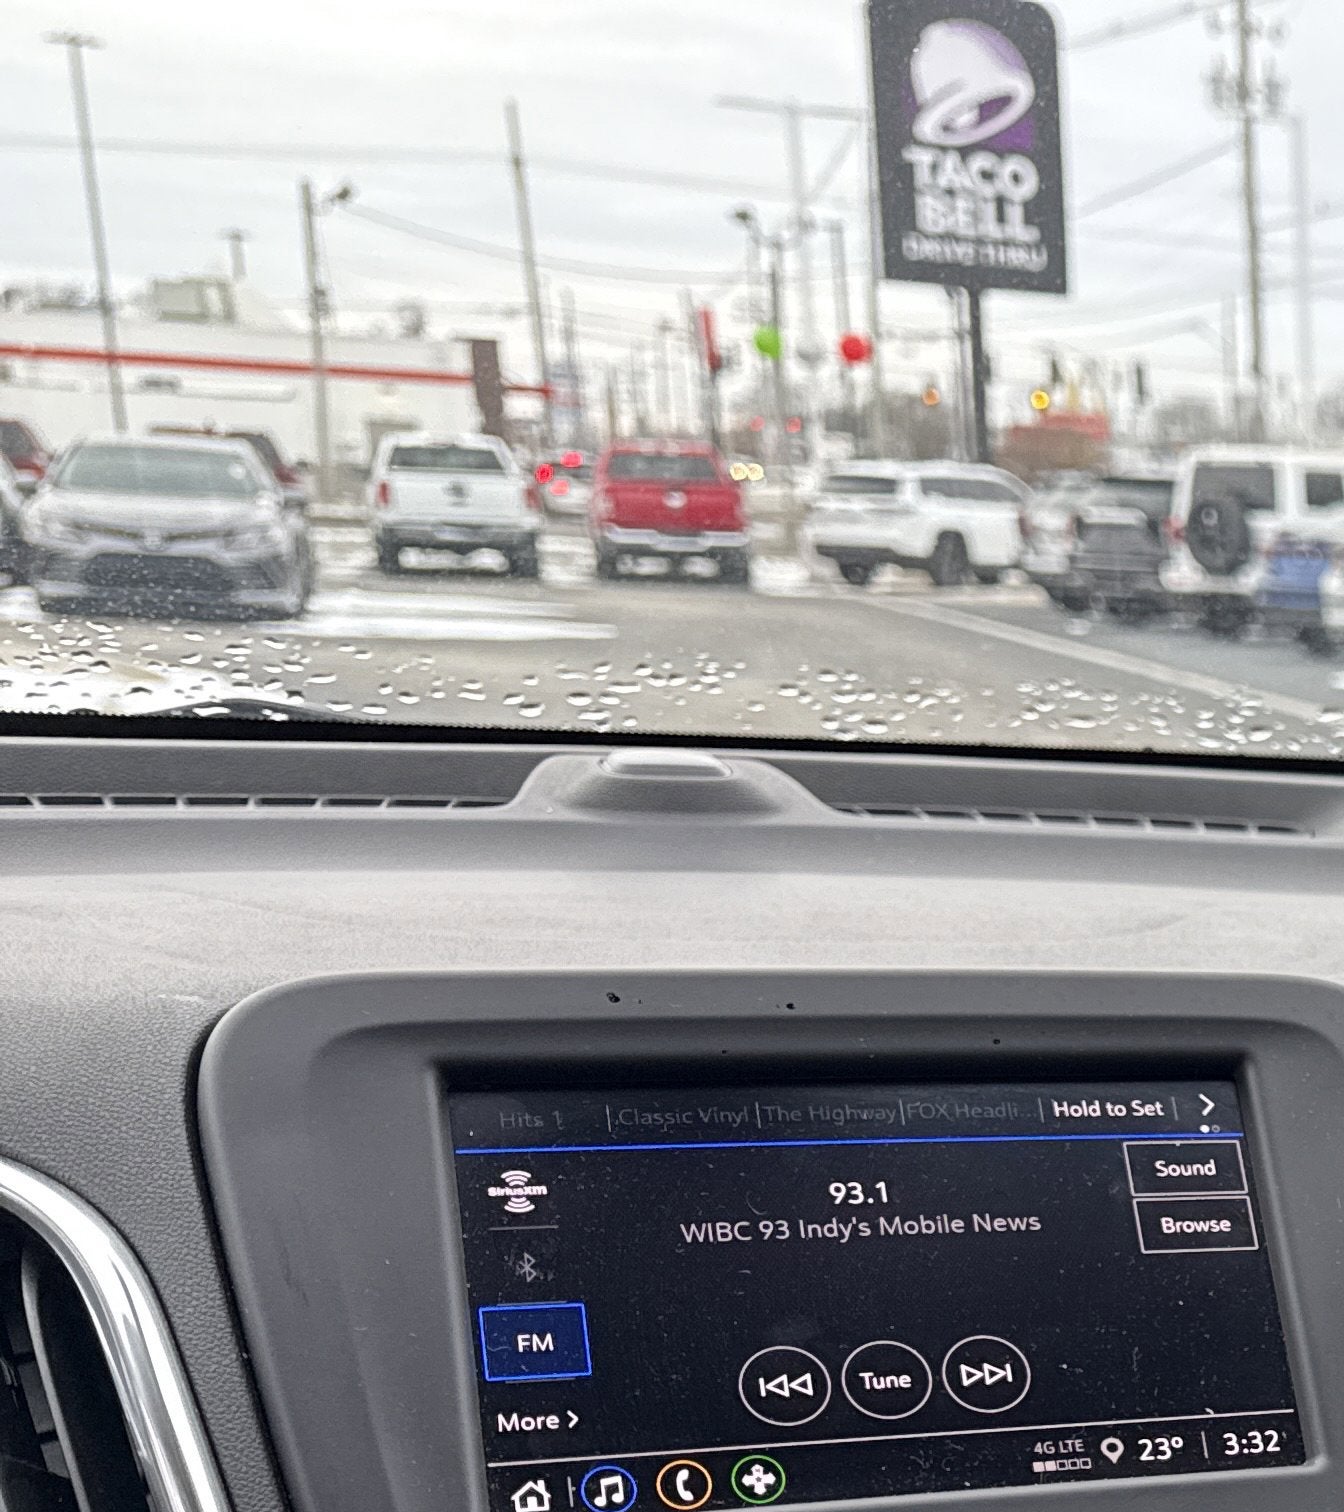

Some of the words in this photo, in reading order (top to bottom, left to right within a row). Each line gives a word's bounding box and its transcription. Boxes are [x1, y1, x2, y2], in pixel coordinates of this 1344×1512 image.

[901, 145, 1040, 202] TACO
[914, 194, 1041, 244] BELL
[618, 1107, 693, 1126] Classic
[698, 1105, 749, 1127] Vinyl
[763, 1104, 801, 1123] The
[808, 1103, 897, 1126] Highway
[907, 1101, 950, 1120] FOX
[1053, 1100, 1101, 1117] Hold
[1105, 1102, 1127, 1117] to
[1131, 1099, 1165, 1117] Set
[500, 1111, 544, 1129] Hits
[1154, 1159, 1217, 1178] Sound
[828, 1181, 888, 1204] 93.1
[680, 1221, 752, 1244] WIBC
[758, 1220, 790, 1240] 93
[799, 1216, 872, 1243] Indy's
[879, 1213, 965, 1236] Mobile
[973, 1212, 1042, 1233] News
[1160, 1216, 1232, 1234] Browse
[517, 1332, 554, 1353] FM
[858, 1372, 912, 1390] Tune
[497, 1412, 560, 1432] More
[1033, 1440, 1056, 1455] 4G
[1059, 1439, 1085, 1453] LTE
[1222, 1430, 1281, 1455] 3:32
